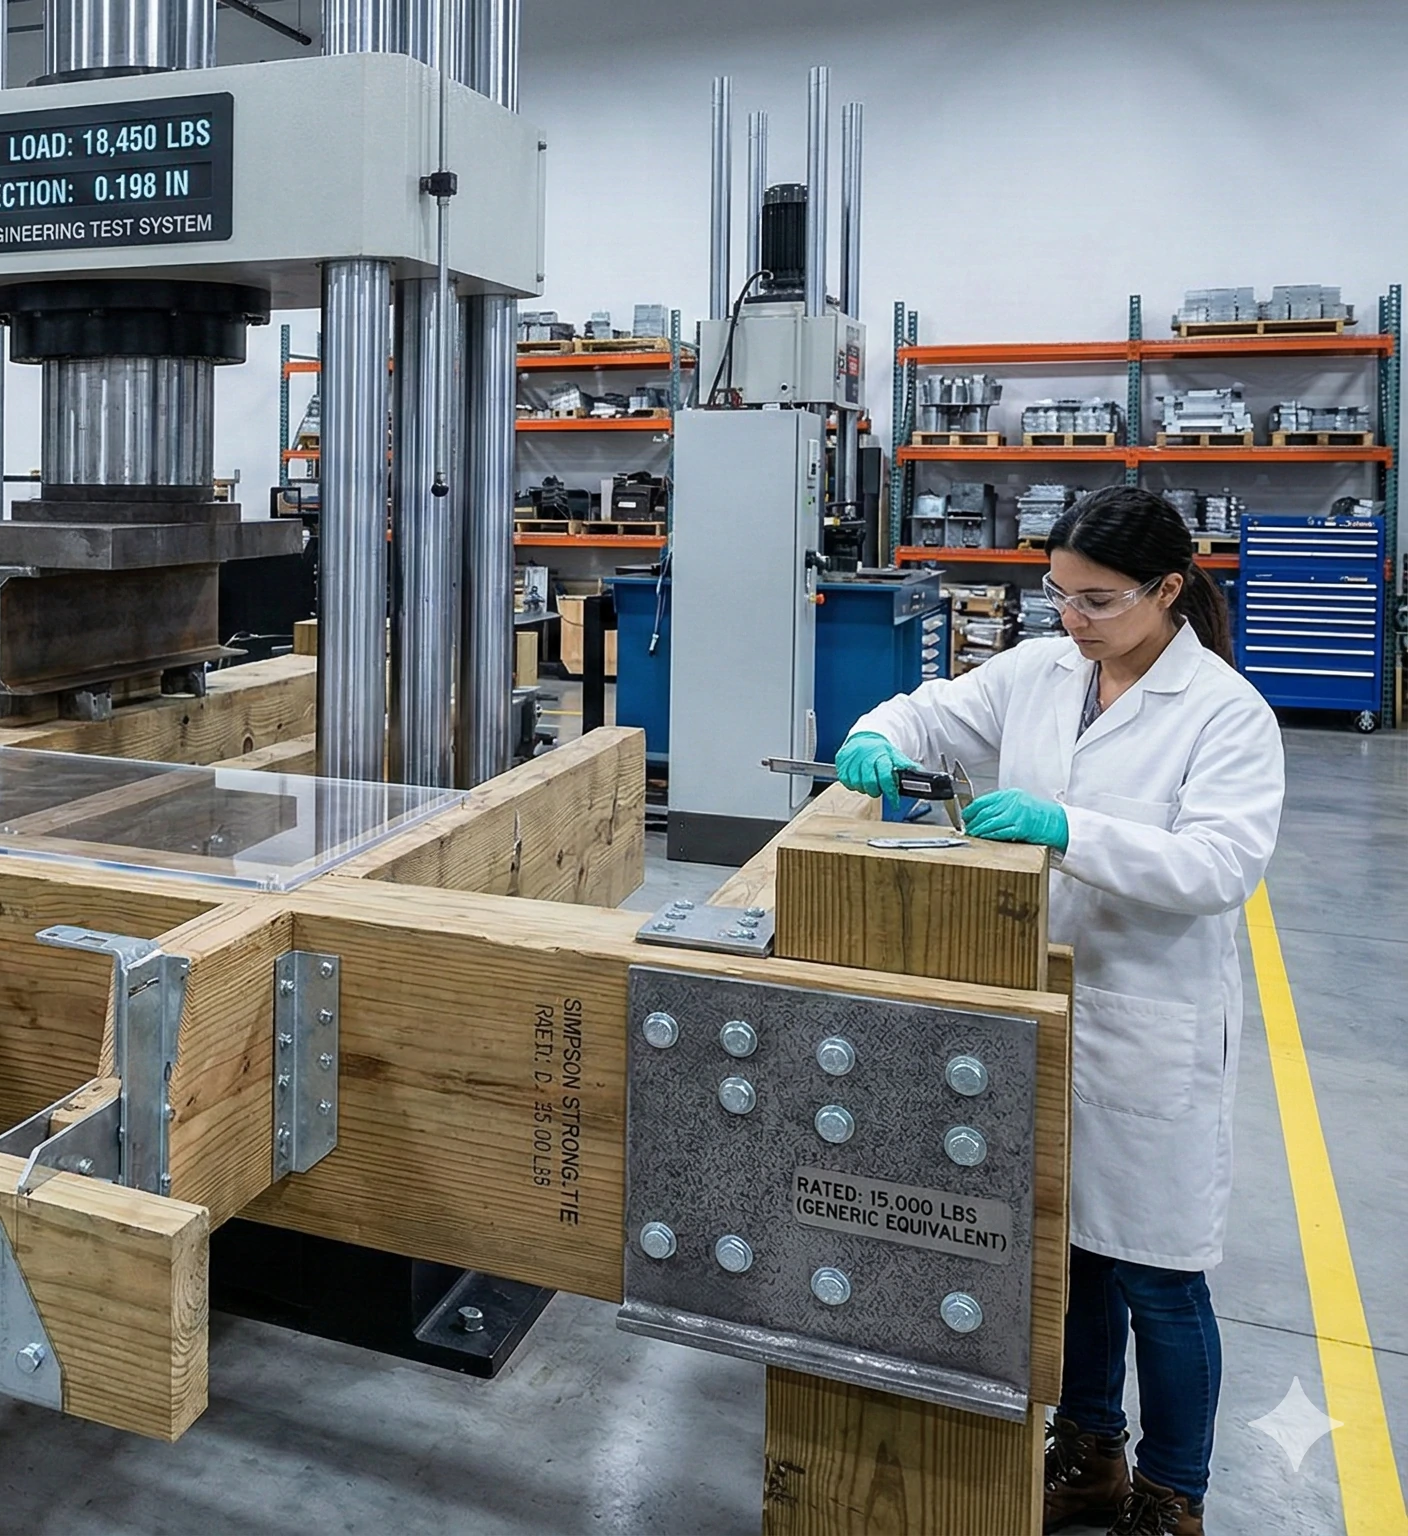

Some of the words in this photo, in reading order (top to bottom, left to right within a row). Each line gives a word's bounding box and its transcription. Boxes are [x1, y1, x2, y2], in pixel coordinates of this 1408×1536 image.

[9, 132, 73, 161] LOAD:
[82, 124, 156, 157] 18,450
[167, 119, 211, 148] LBS
[95, 172, 156, 201] 0.198
[165, 169, 189, 196] IN
[90, 218, 134, 238] TEST
[139, 214, 212, 235] SYSTEM
[562, 998, 582, 1090] SIMPSON
[797, 1176, 863, 1203] RATED:
[941, 1203, 978, 1224] LBS
[796, 1196, 879, 1227] (GENERIC
[886, 1214, 1007, 1252] EQUIVALENT)
